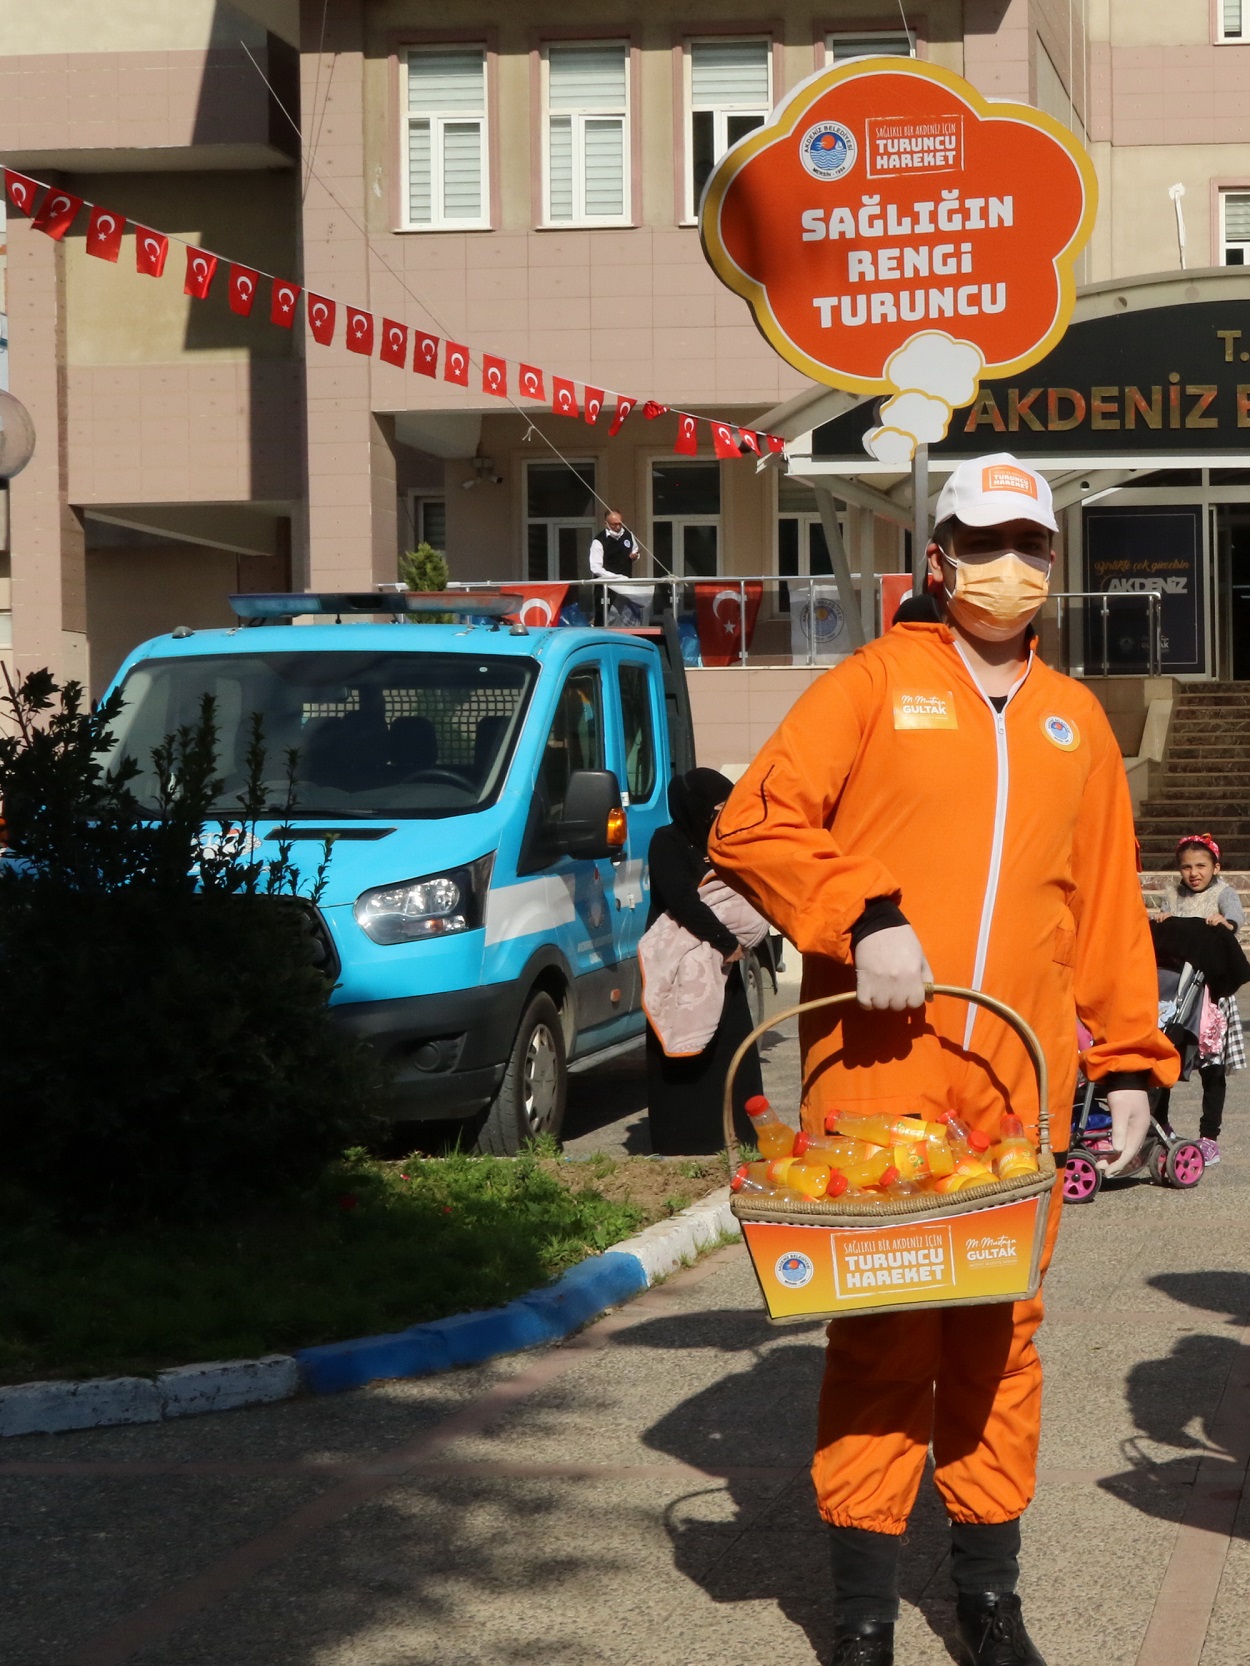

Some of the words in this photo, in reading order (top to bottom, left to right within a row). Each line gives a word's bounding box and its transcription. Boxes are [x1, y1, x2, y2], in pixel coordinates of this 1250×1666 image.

[876, 135, 956, 154] TURUNCU
[876, 151, 956, 169] HAREKET
[801, 189, 1014, 242] SAĞLIĞIN
[847, 242, 973, 283] RENGİ
[812, 282, 1006, 328] TURUNCU
[964, 372, 1218, 433] AKDENİZ
[843, 1240, 876, 1254] SAĞLIKLI
[878, 1238, 891, 1251] BİR
[892, 1235, 923, 1250] AKDENİZ
[845, 1248, 944, 1271] TURUNCU
[846, 1264, 945, 1288] HAREKET
